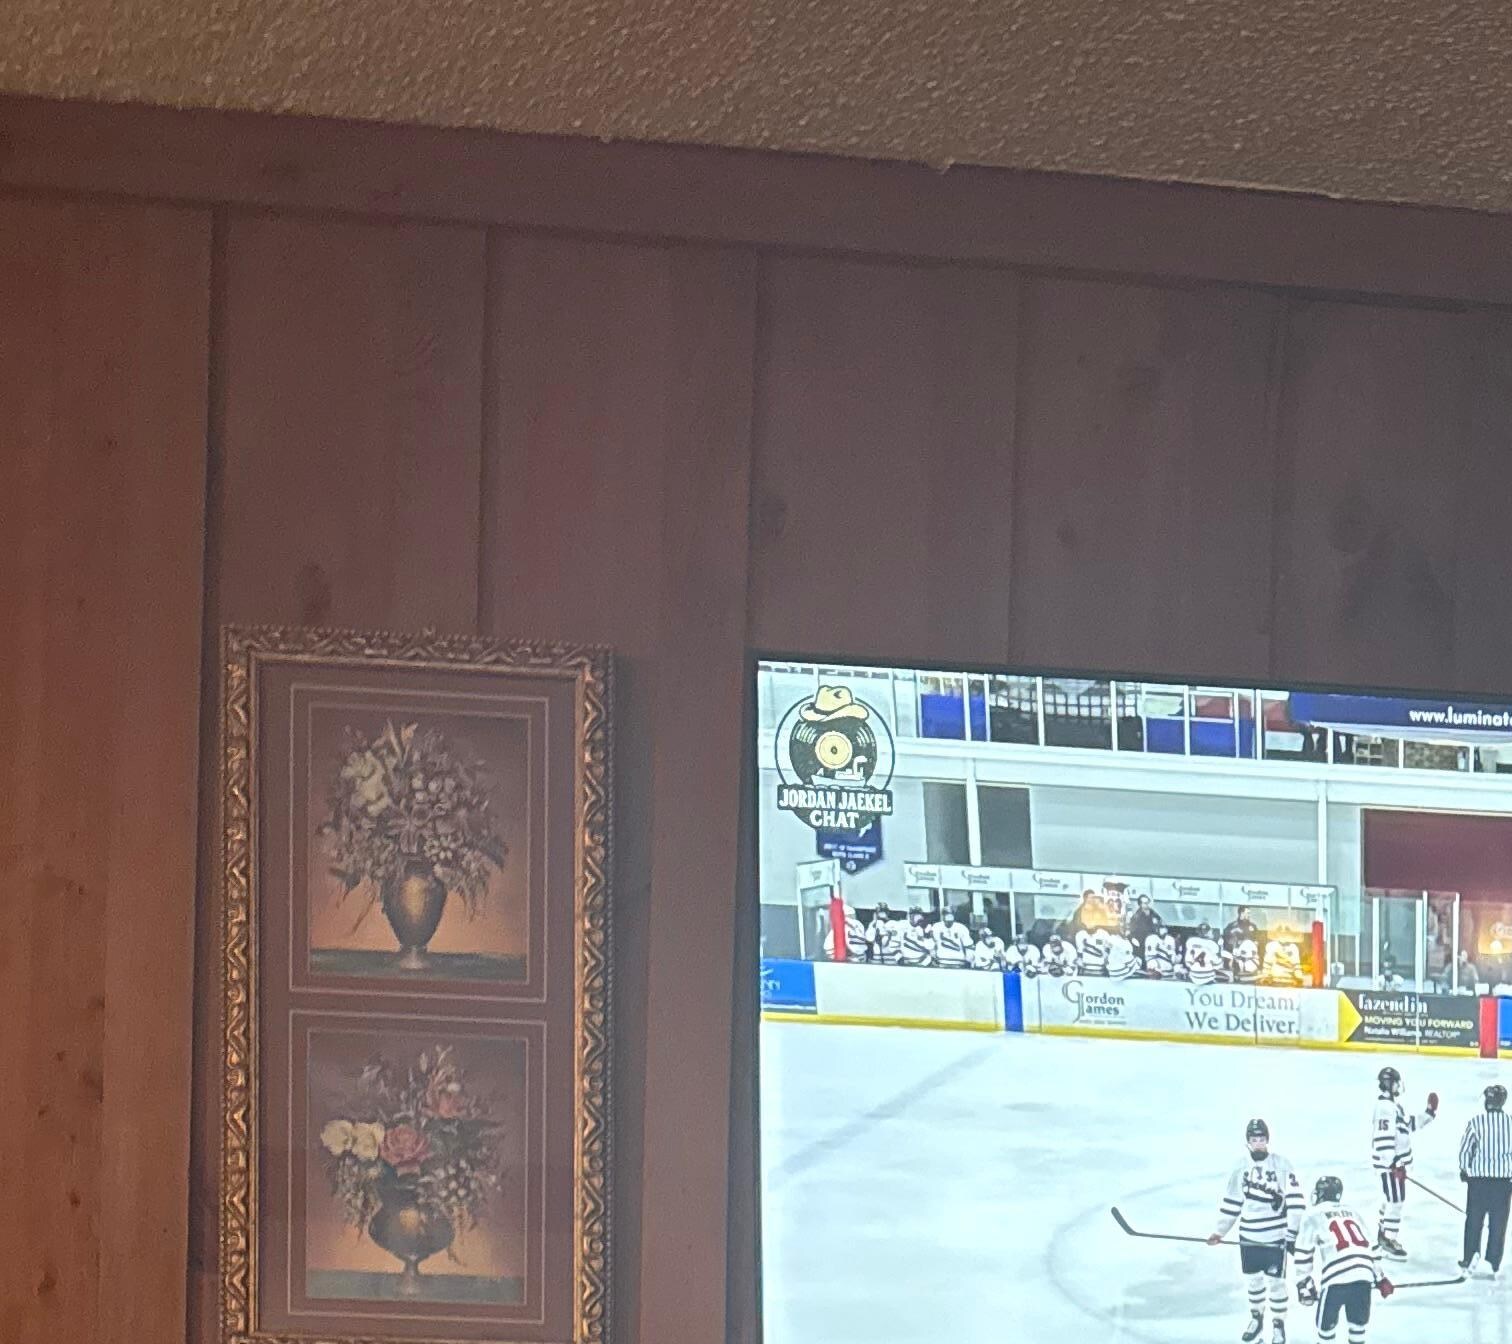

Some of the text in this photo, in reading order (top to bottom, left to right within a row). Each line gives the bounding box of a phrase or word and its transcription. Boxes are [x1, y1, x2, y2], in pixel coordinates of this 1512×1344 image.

[779, 789, 892, 811] JORDAN JAEKEL
[810, 810, 859, 828] CHAT
[1185, 988, 1300, 1011] You Dream.
[1185, 1011, 1300, 1034] We Deliver.
[1329, 1220, 1369, 1252] 10
